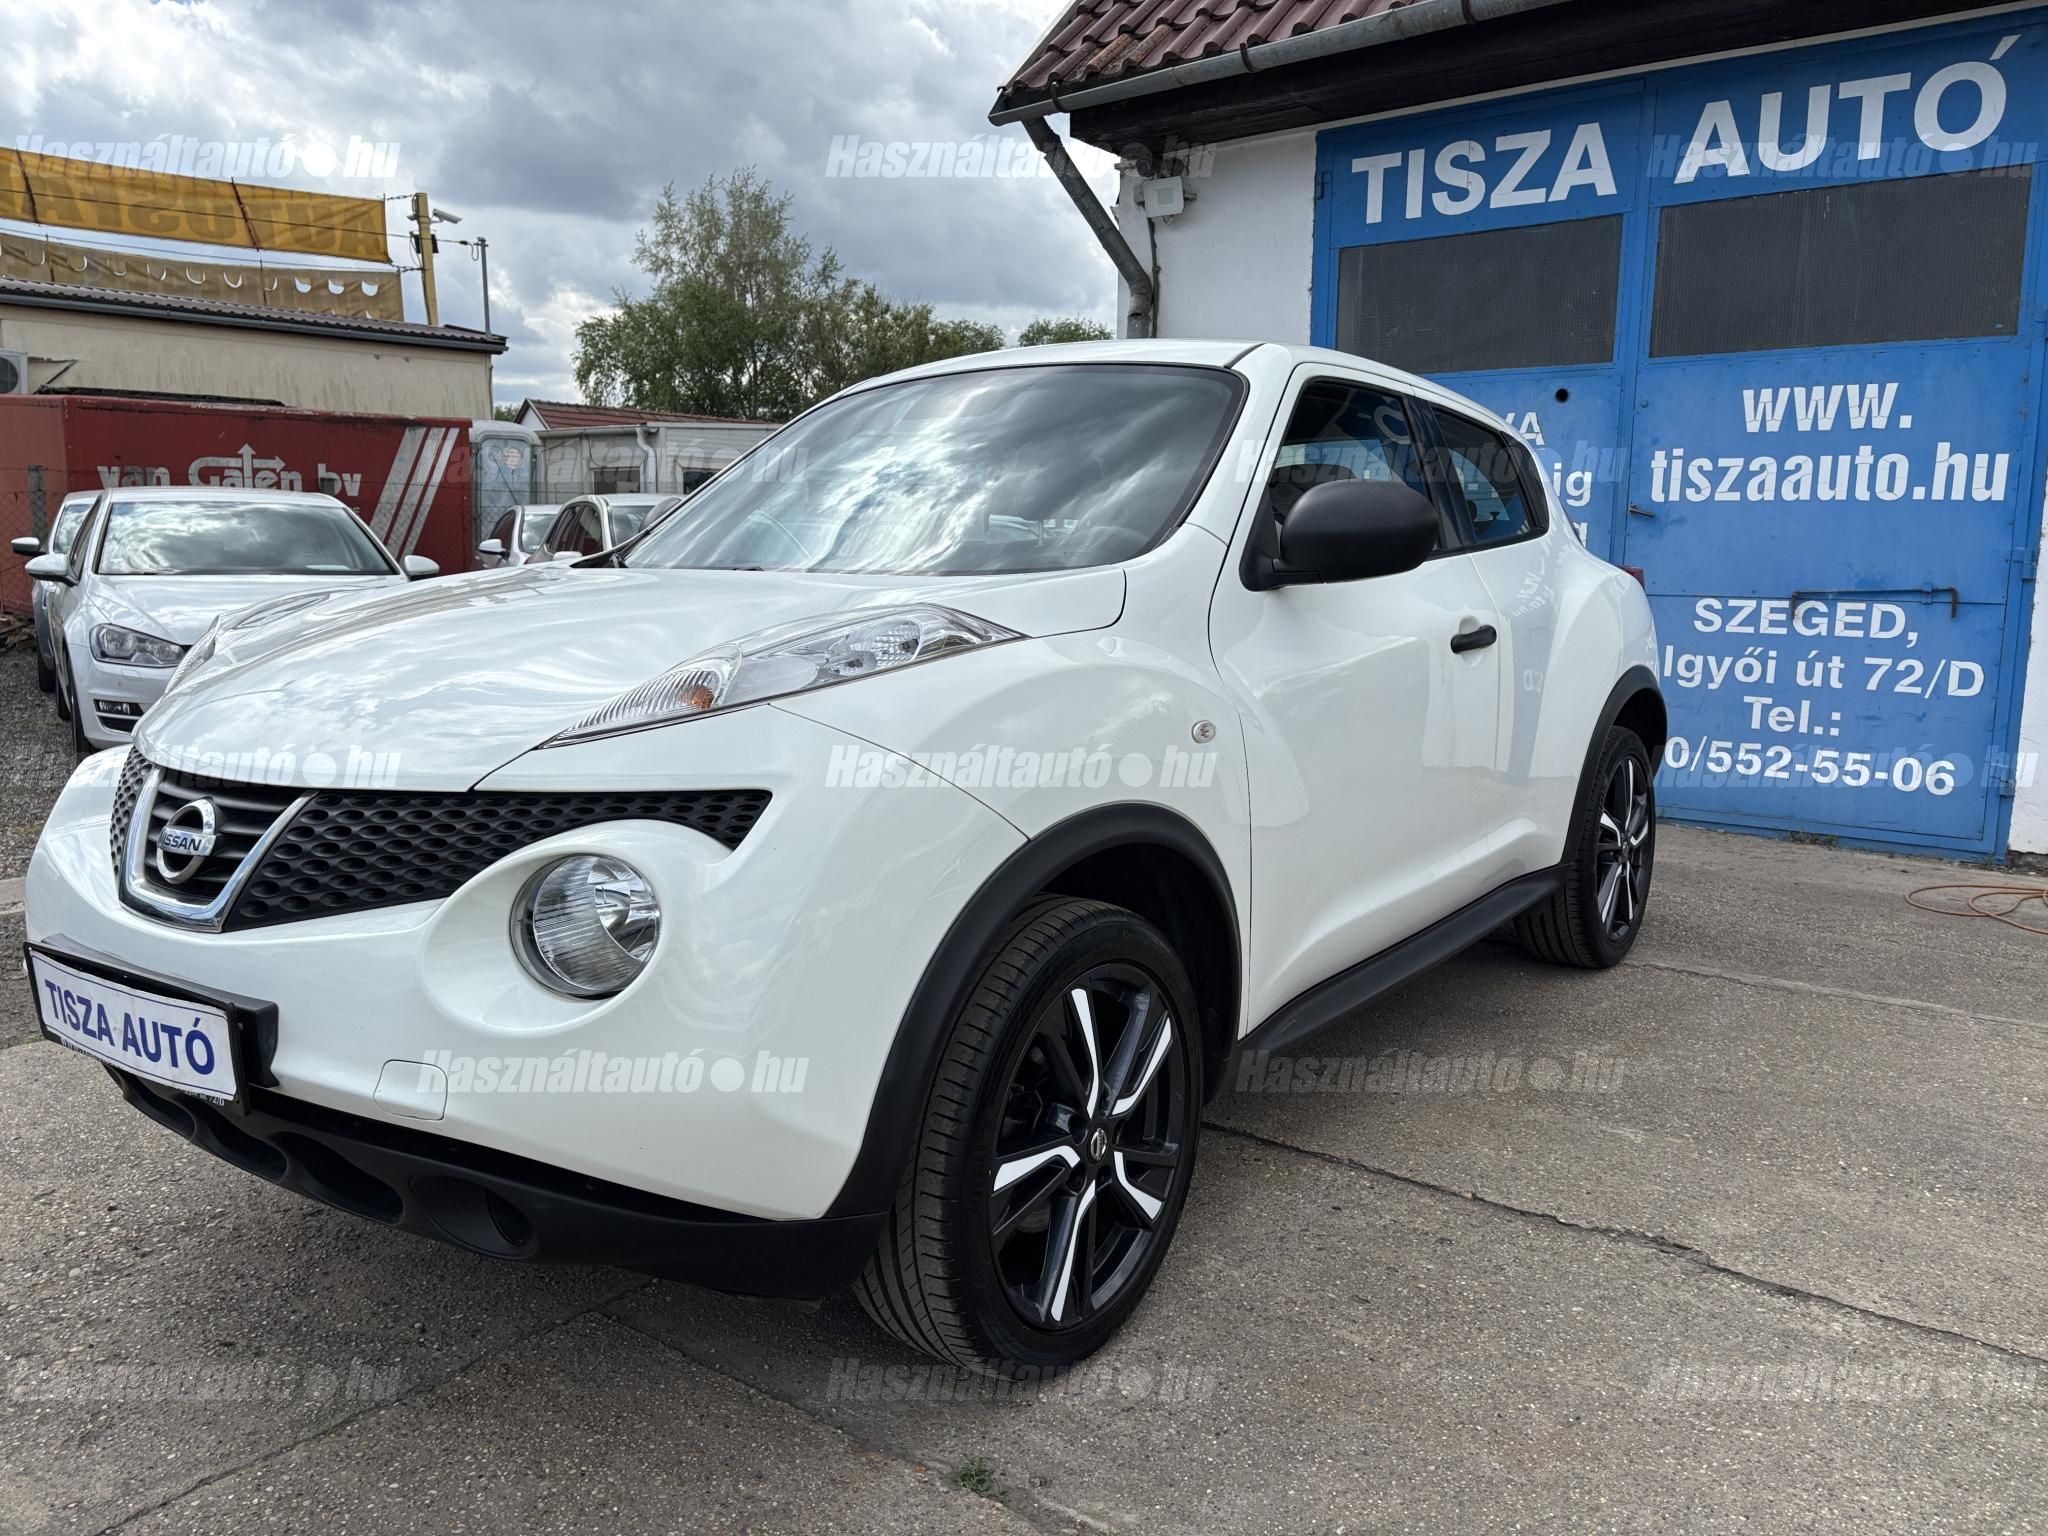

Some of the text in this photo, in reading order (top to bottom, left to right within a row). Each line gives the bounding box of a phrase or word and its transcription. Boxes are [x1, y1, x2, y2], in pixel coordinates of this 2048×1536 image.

[1351, 34, 2023, 225] TISZA AUTÓ
[1743, 382, 1914, 433] www.
[97, 443, 362, 497] van Galen bv
[1553, 462, 1592, 507] ig
[1650, 442, 2010, 503] tiszaauto.hu
[1693, 599, 1919, 648] SZEGED,
[1664, 646, 1985, 699] lgyői út 72/D
[1744, 696, 1841, 736] Tel.:
[1665, 737, 1956, 796] 0/552-55-06
[159, 831, 202, 852] NISSAN
[44, 978, 216, 1076] TISZA AUTÓ
